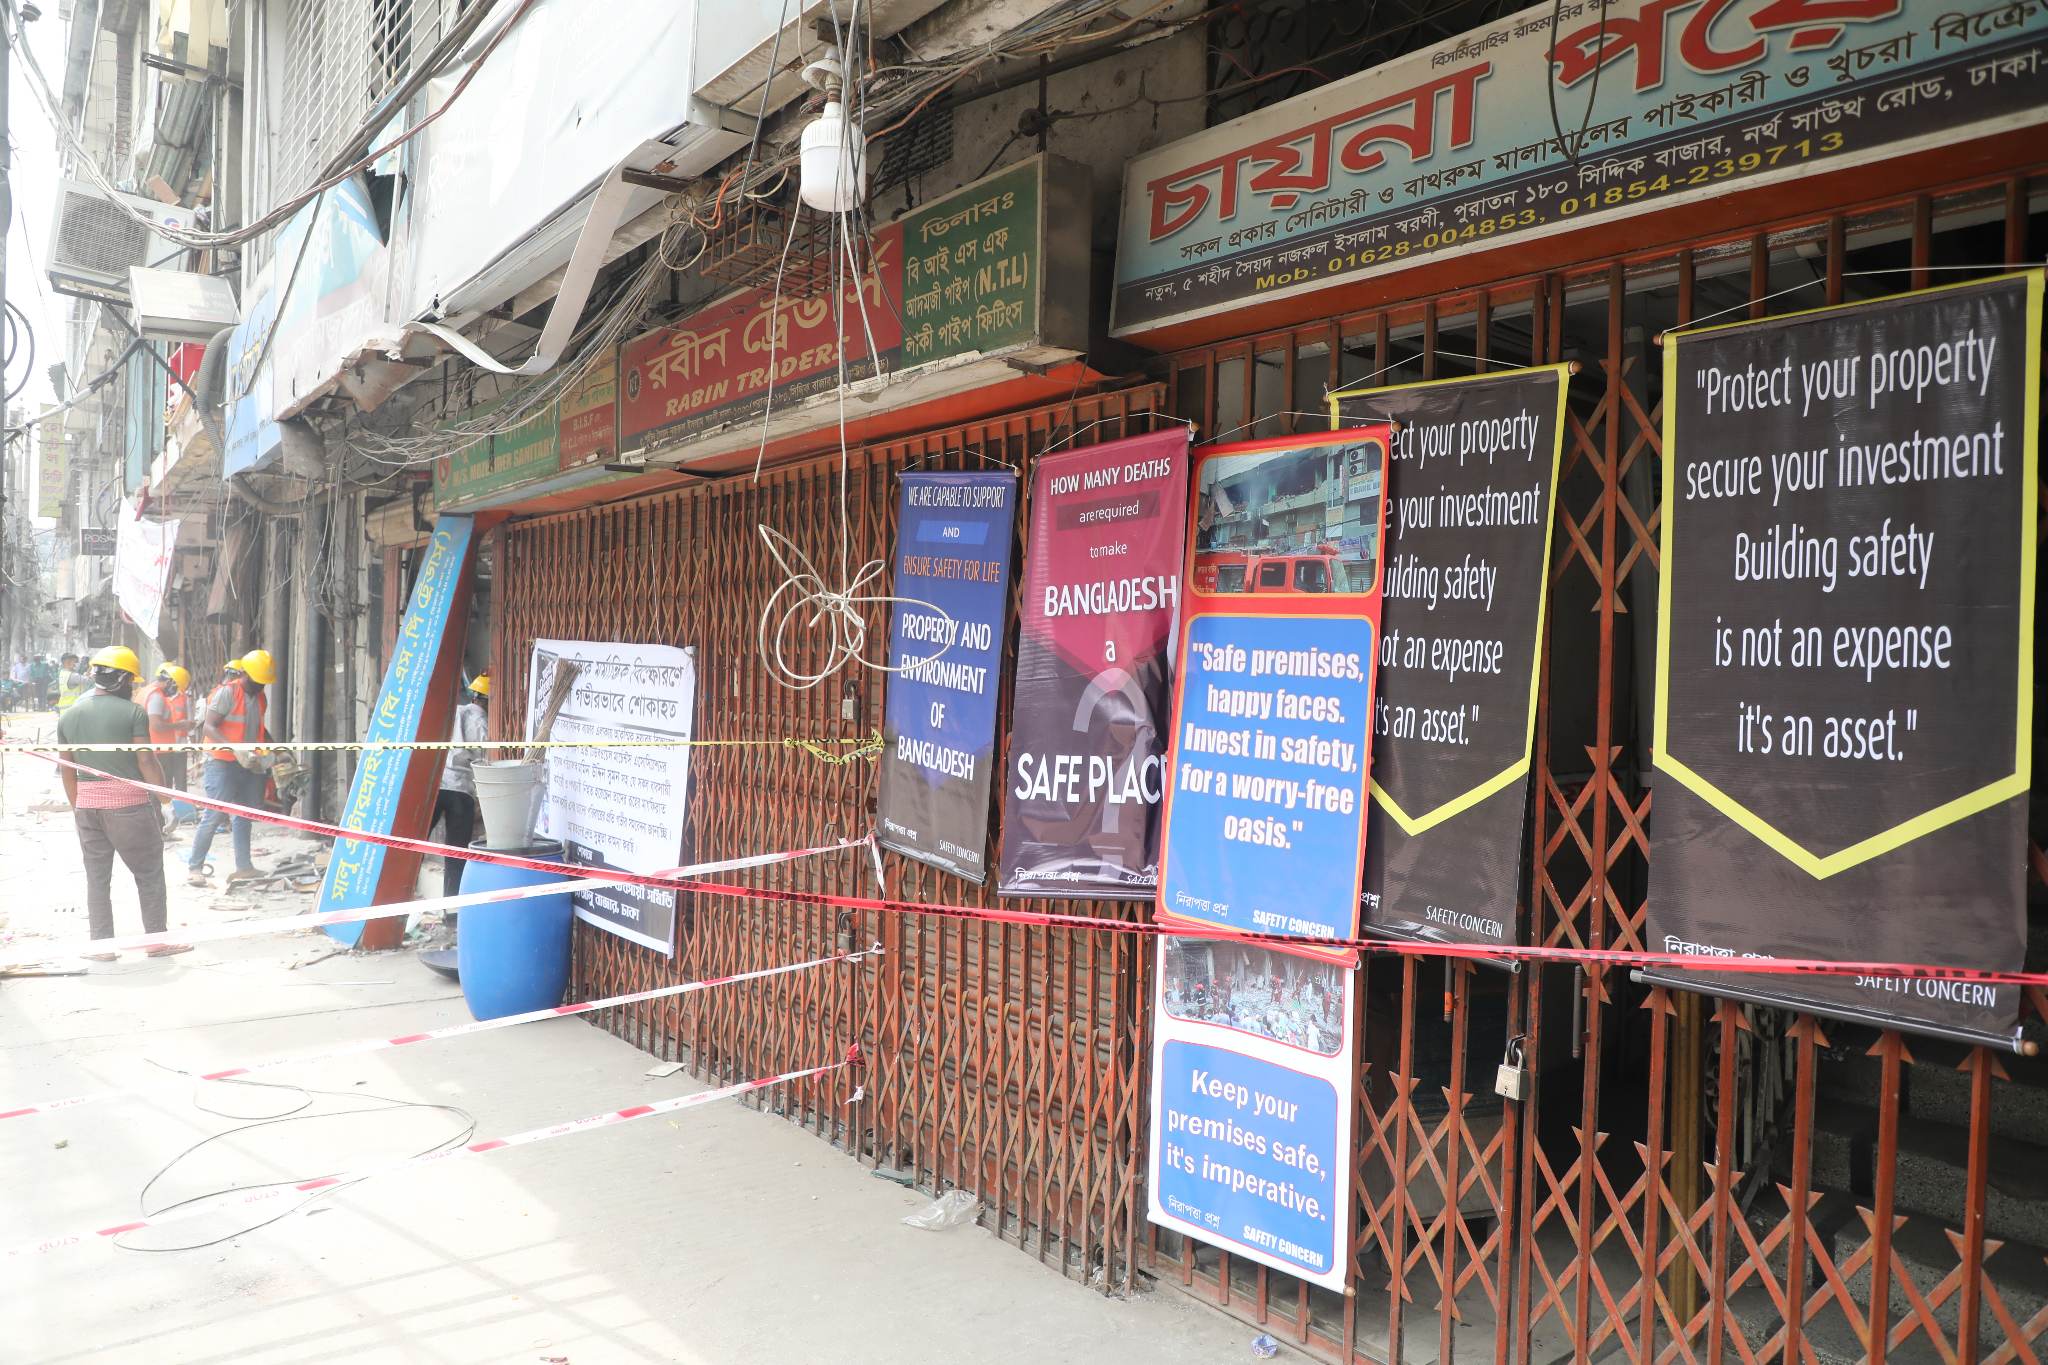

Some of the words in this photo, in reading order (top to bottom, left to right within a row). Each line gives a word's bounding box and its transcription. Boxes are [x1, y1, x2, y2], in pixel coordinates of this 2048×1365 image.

[1432, 26, 1508, 69] বিসমিল্লাহির
[1147, 61, 1491, 241] চায়না
[1180, 236, 1220, 261] সকল
[1228, 219, 1279, 247] প্রকার
[1285, 190, 1370, 232] সেনিটারী
[1378, 187, 1394, 204] ও
[1403, 158, 1486, 197] বাথরুম
[1644, 71, 1770, 128] পাইকারী
[1785, 65, 1809, 86] ও
[1826, 31, 1918, 82] খুচরা
[1931, 0, 2048, 50] বিক্রে
[1146, 281, 1177, 303] নতুন,
[1199, 264, 1231, 287] শহীদ
[1236, 252, 1272, 278] সৈয়দ
[1278, 239, 1328, 267] নজরুল
[1334, 224, 1388, 253] ইসলাম
[1454, 190, 1518, 223] পুরাতন
[1526, 180, 1568, 202] ১৮০
[1577, 154, 1647, 189] সিদ্দিক
[1655, 135, 1732, 169] বাজার,
[1742, 112, 1782, 144] নর্থ
[1790, 96, 1865, 131] সাউথ
[1877, 77, 1953, 112] রোড,
[1255, 265, 1318, 290] Mob:
[1328, 208, 1546, 273] 01628-004853,
[1560, 132, 1844, 216] 01854-239713
[906, 257, 920, 286] বি
[924, 246, 949, 276] আই
[955, 239, 977, 265] এস
[983, 227, 1008, 255] এফ
[906, 282, 941, 319] আদমজী
[945, 276, 970, 306] পাইপ
[975, 252, 1028, 303] (N.T.L)
[906, 323, 933, 356] লাকী
[938, 315, 971, 346] পাইপ
[976, 299, 1023, 336] ফিটিংস
[647, 327, 731, 389] রবীন
[1697, 357, 1792, 414] "Protect
[1802, 356, 1861, 417] your
[1870, 329, 1996, 409] property
[666, 379, 728, 416] RABIN
[1419, 422, 1455, 470] your
[1460, 408, 1539, 466] property
[1051, 474, 1080, 496] HOW
[1083, 467, 1121, 490] MANY
[1124, 457, 1171, 483] DEATHS
[1686, 454, 1761, 500] secure
[1772, 448, 1829, 506] your
[1839, 422, 2005, 487] investment
[908, 486, 921, 506] WE
[919, 487, 932, 506] ARE
[932, 486, 961, 507] CAPABLE
[962, 487, 973, 507] TO
[973, 486, 1005, 508] SUPPORT
[1399, 494, 1435, 540] your
[1440, 482, 1540, 528] investment
[942, 527, 960, 538] AND
[903, 555, 931, 576] ENSURE
[932, 557, 962, 580] SAFETY
[963, 560, 980, 581] FOR
[982, 562, 1000, 583] LIFE
[1735, 524, 1838, 593] Building
[1848, 518, 1934, 589] safety
[1044, 575, 1177, 617] BANGLADESH
[1382, 554, 1439, 611] uilding
[1443, 553, 1497, 612] safety
[902, 613, 960, 646] PROPERTY
[960, 621, 991, 651] AND
[1105, 641, 1116, 661] a
[1715, 616, 1733, 666] is
[1742, 618, 1782, 667] not
[1791, 626, 1822, 667] an
[1833, 625, 1952, 682] expense
[900, 654, 987, 694] ENVIRONMENT
[1192, 643, 1247, 673] "Safe
[1251, 647, 1364, 683] premises,
[1404, 637, 1426, 669] an
[1431, 638, 1503, 683] expense
[575, 683, 626, 712] গভীরভাবে
[629, 693, 679, 720] শোকাহত
[930, 702, 945, 729] OF
[1207, 684, 1273, 720] happy
[1276, 689, 1345, 724] faces.
[1375, 697, 1389, 736] t's
[1393, 706, 1416, 739] an
[1184, 723, 1251, 758] Invest
[1255, 730, 1276, 761] in
[1281, 735, 1357, 773] safety,
[1738, 702, 1772, 754] it's
[1781, 715, 1813, 756] an
[897, 736, 975, 781] BANGLADESH
[1015, 753, 1082, 803] SAFE
[1180, 763, 1213, 794] for
[1215, 772, 1227, 796] a
[1232, 774, 1354, 815] worry-free
[939, 840, 956, 856] SAFETY
[956, 844, 980, 864] CONCERN
[1224, 815, 1303, 850] oasis."
[621, 904, 640, 921] ঢাকা
[1252, 909, 1288, 930] SAFETY
[1288, 916, 1335, 938] CONCERN
[1425, 905, 1459, 927] SAFETY
[1459, 912, 1503, 938] CONCERN
[1855, 976, 1911, 996] SAFETY
[1916, 979, 1998, 1008] CONCERN
[1192, 1069, 1248, 1109] Keep
[1253, 1091, 1298, 1122] your
[1168, 1109, 1267, 1155] premises
[1272, 1141, 1326, 1182] safe,
[1167, 1142, 1195, 1175] it's
[1202, 1153, 1326, 1221] imperative.
[1243, 1225, 1278, 1249] SAFETY
[1278, 1238, 1324, 1268] CONCERN
